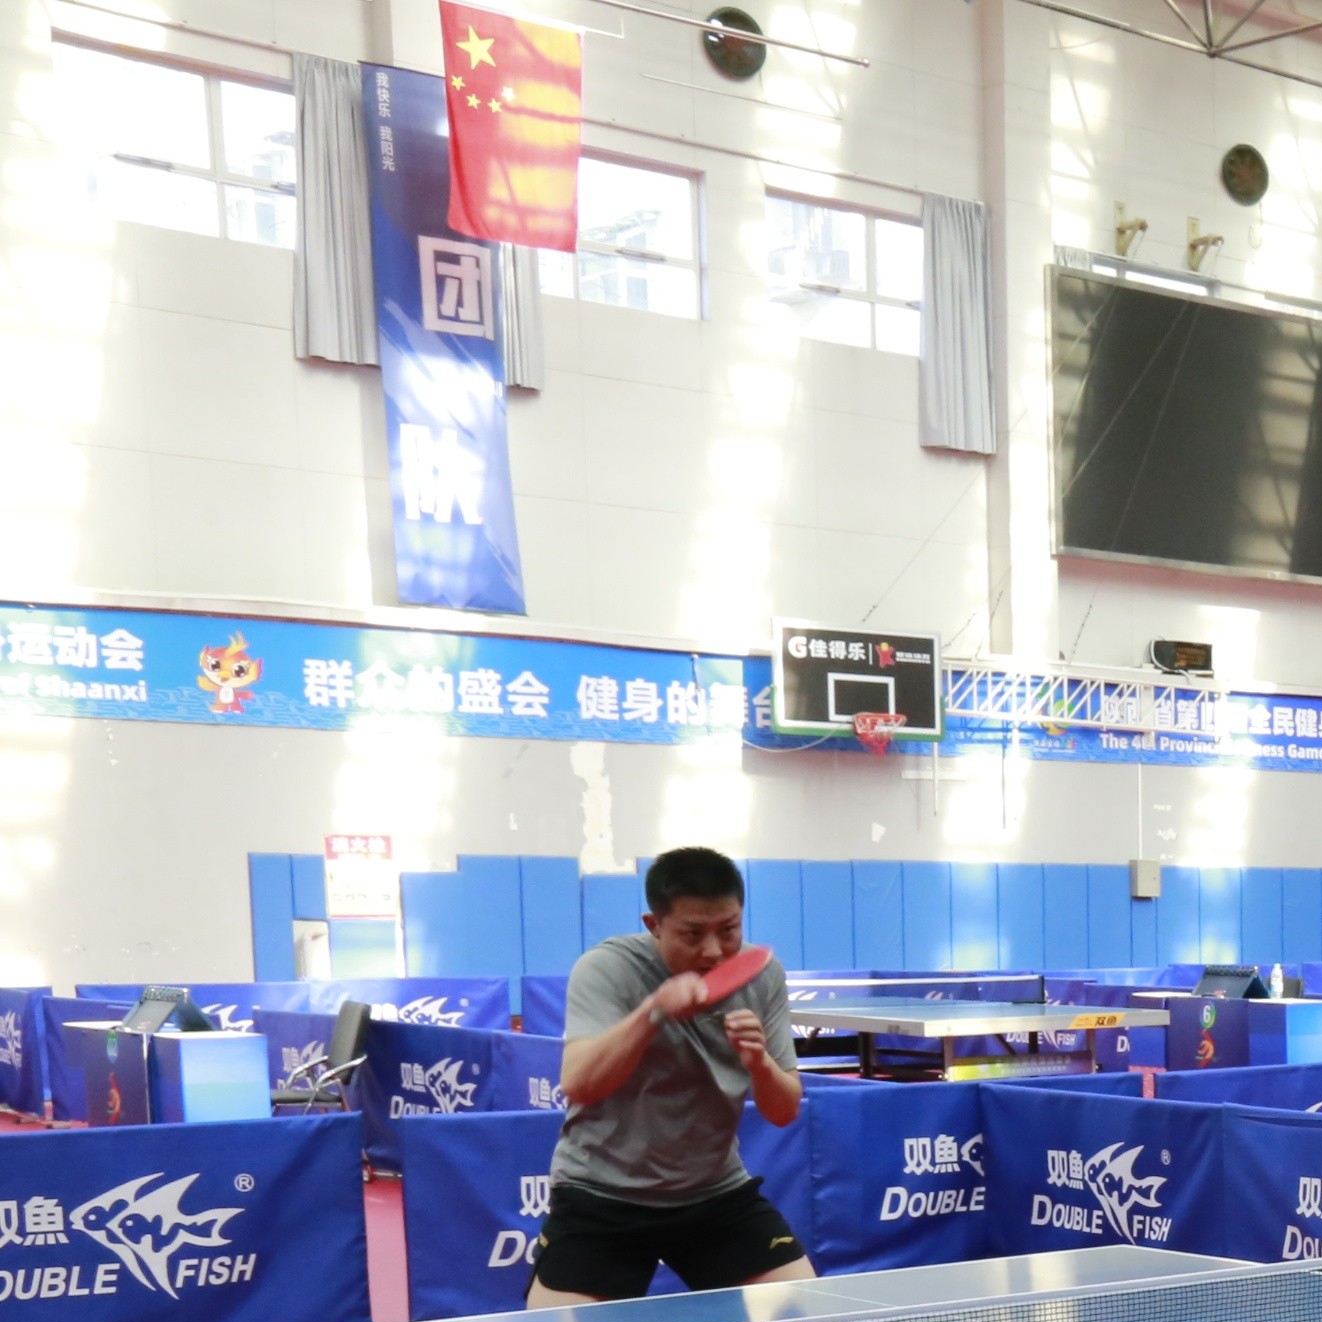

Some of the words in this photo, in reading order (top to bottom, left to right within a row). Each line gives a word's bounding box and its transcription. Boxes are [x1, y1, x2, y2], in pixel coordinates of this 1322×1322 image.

[418, 235, 494, 340] 团
[0, 621, 144, 671] 运动会
[809, 639, 866, 661] 佳得乐
[35, 675, 147, 702] Shaanxi
[303, 659, 550, 718] 群众的盛会
[1100, 732, 1128, 750] The
[1203, 1006, 1211, 1022] 6
[880, 1186, 985, 1222] DOUBLE
[1030, 1194, 1103, 1235] DOUBLE
[1132, 1214, 1172, 1242] FISH
[176, 1253, 256, 1289] FISH
